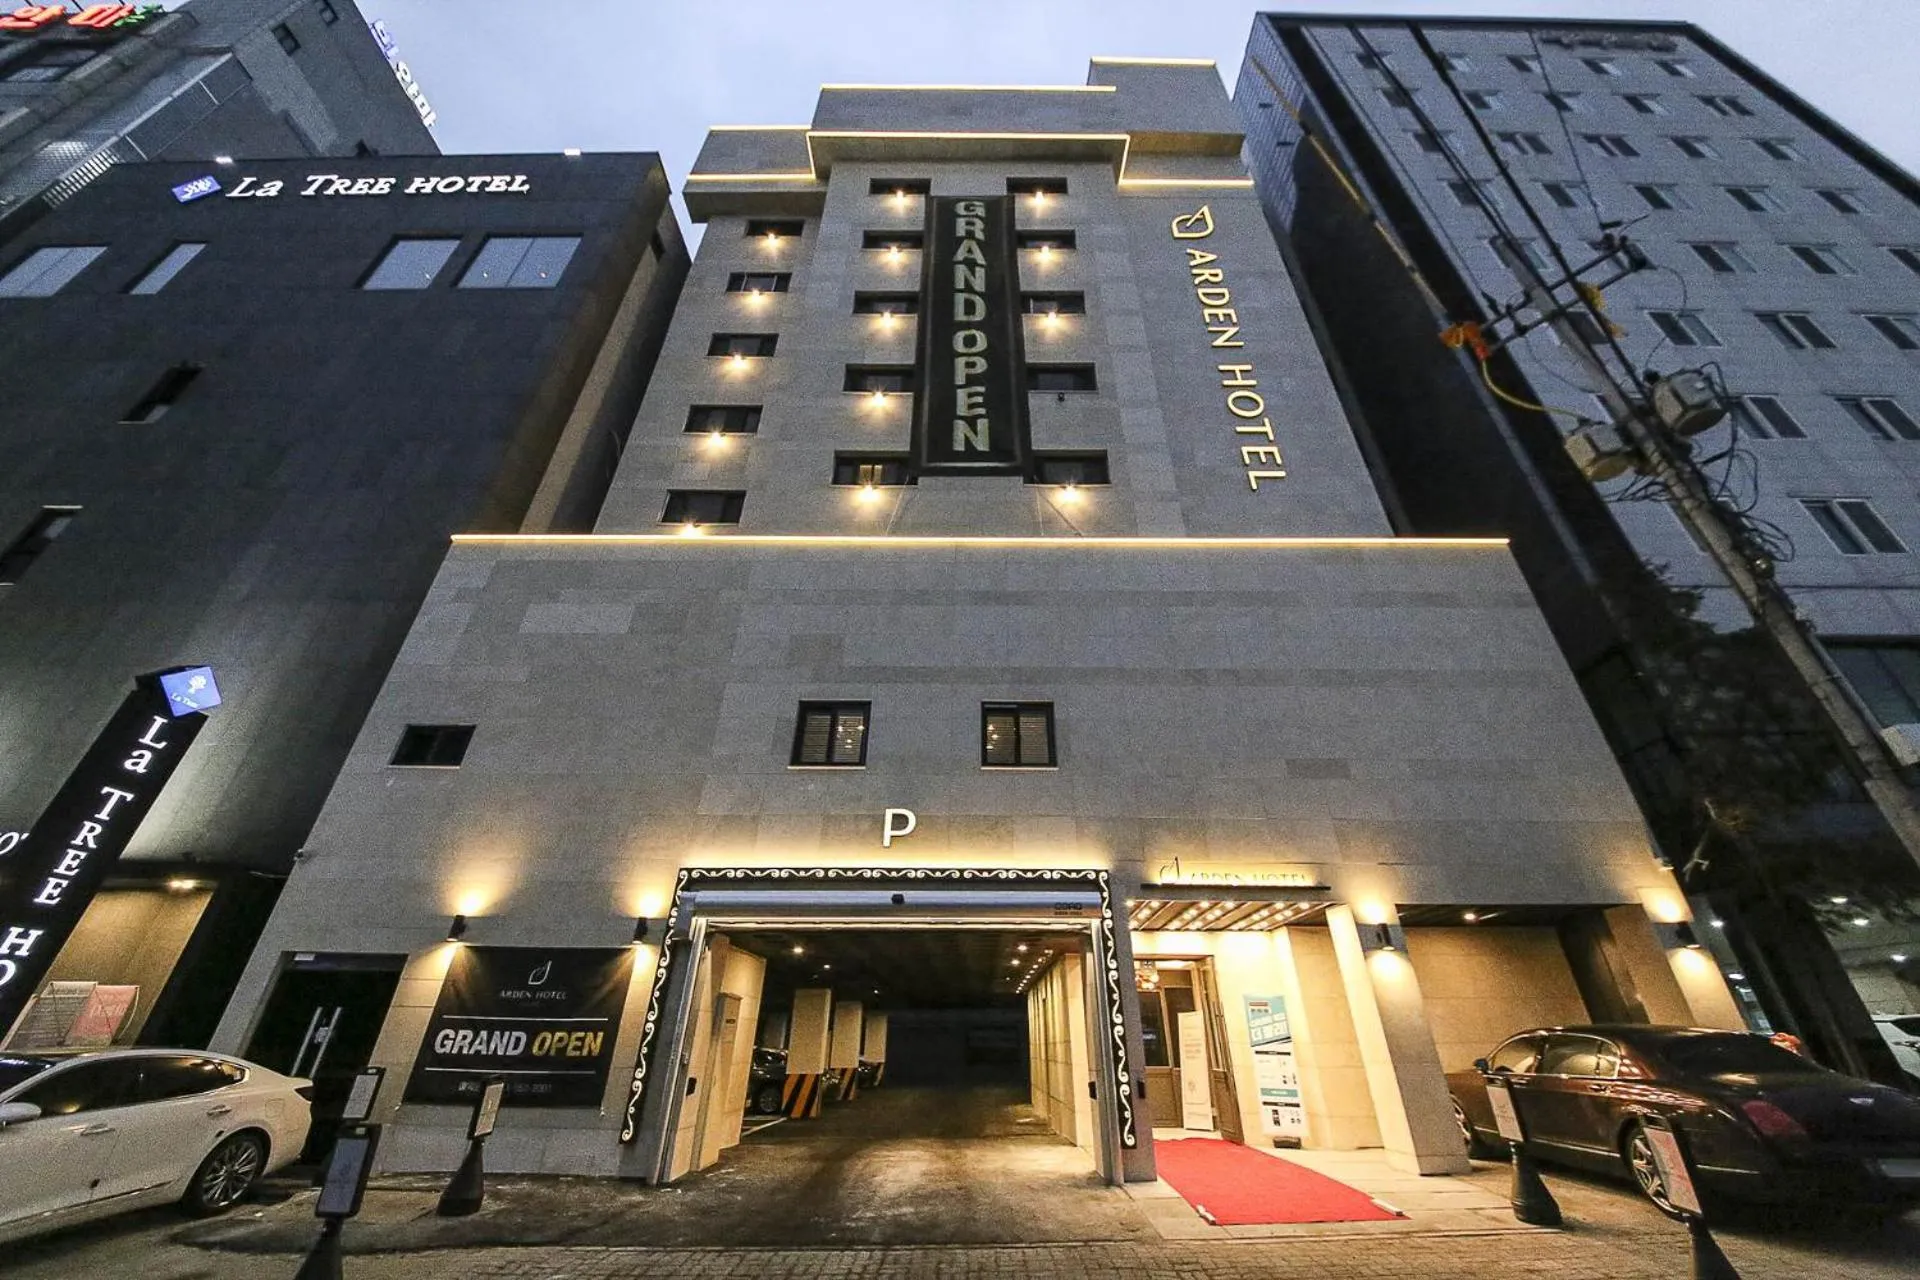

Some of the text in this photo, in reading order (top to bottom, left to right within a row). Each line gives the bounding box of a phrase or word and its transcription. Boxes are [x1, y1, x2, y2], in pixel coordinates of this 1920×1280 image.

[225, 174, 531, 197] La TREE HOTEL
[953, 201, 990, 452] GRAND OPEN
[1186, 248, 1287, 491] ARDEN HOTEL
[123, 715, 169, 774] La
[33, 786, 135, 906] TREE
[882, 808, 916, 847] P
[535, 990, 567, 1000] HOTEL
[434, 1028, 604, 1057] GRAND OPEN
